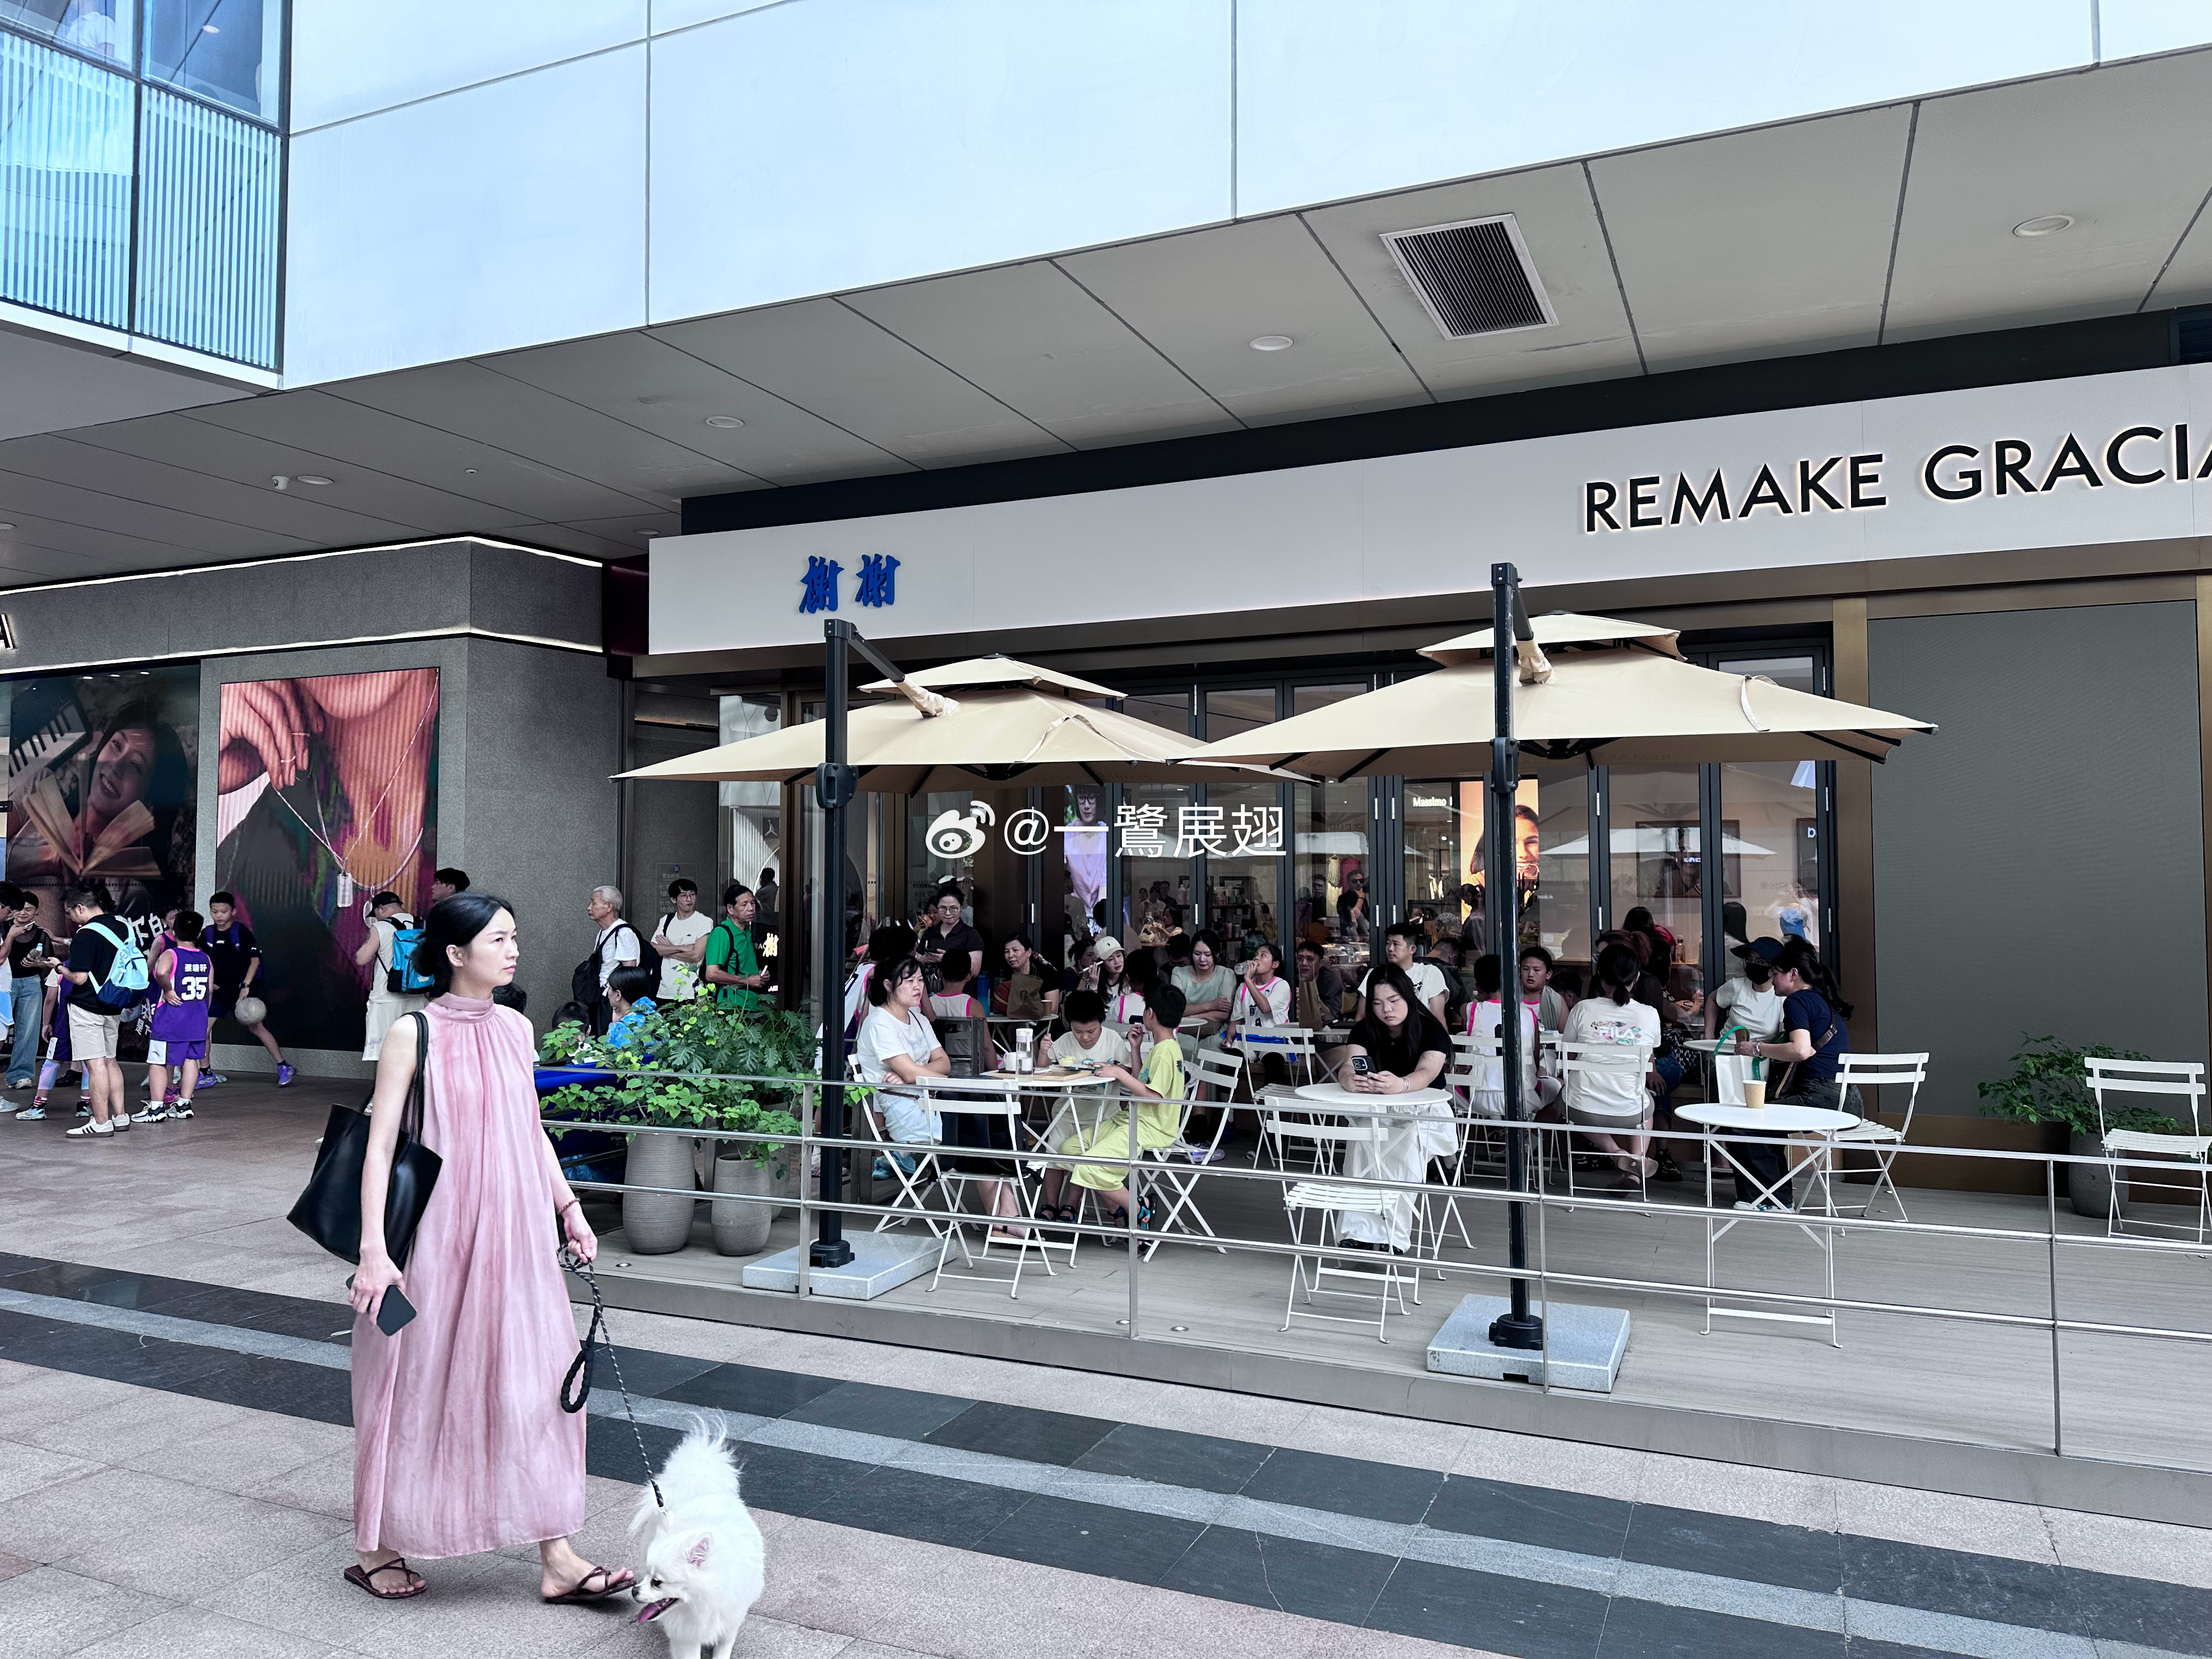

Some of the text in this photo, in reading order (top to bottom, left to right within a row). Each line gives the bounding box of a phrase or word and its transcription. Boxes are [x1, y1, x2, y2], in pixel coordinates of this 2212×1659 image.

[1585, 454, 1887, 532] REMAKE
[1413, 797, 1447, 806] Massimo
[181, 976, 208, 1001] 35
[1599, 1026, 1635, 1039] FILA
